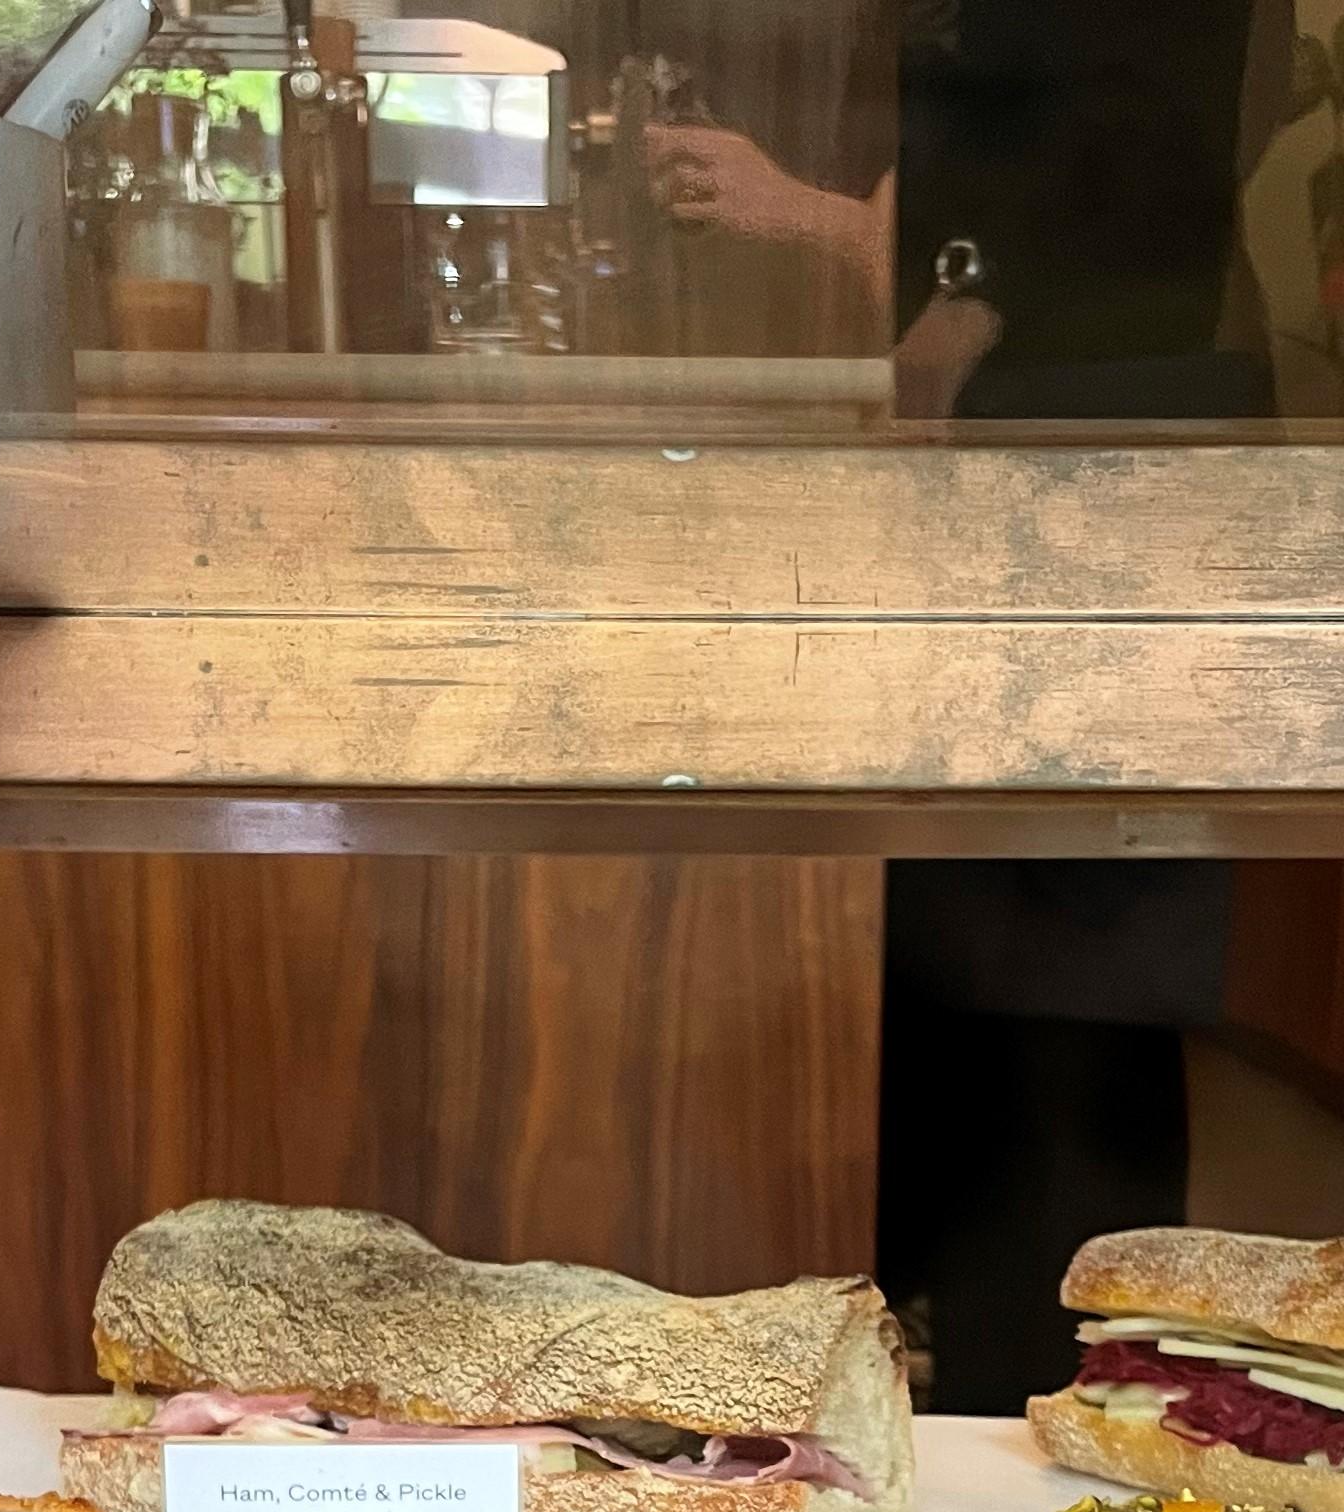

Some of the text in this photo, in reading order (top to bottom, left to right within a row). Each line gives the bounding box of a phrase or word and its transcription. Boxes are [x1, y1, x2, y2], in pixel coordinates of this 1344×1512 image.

[220, 1483, 467, 1504] Ham, Comté & Pickle
